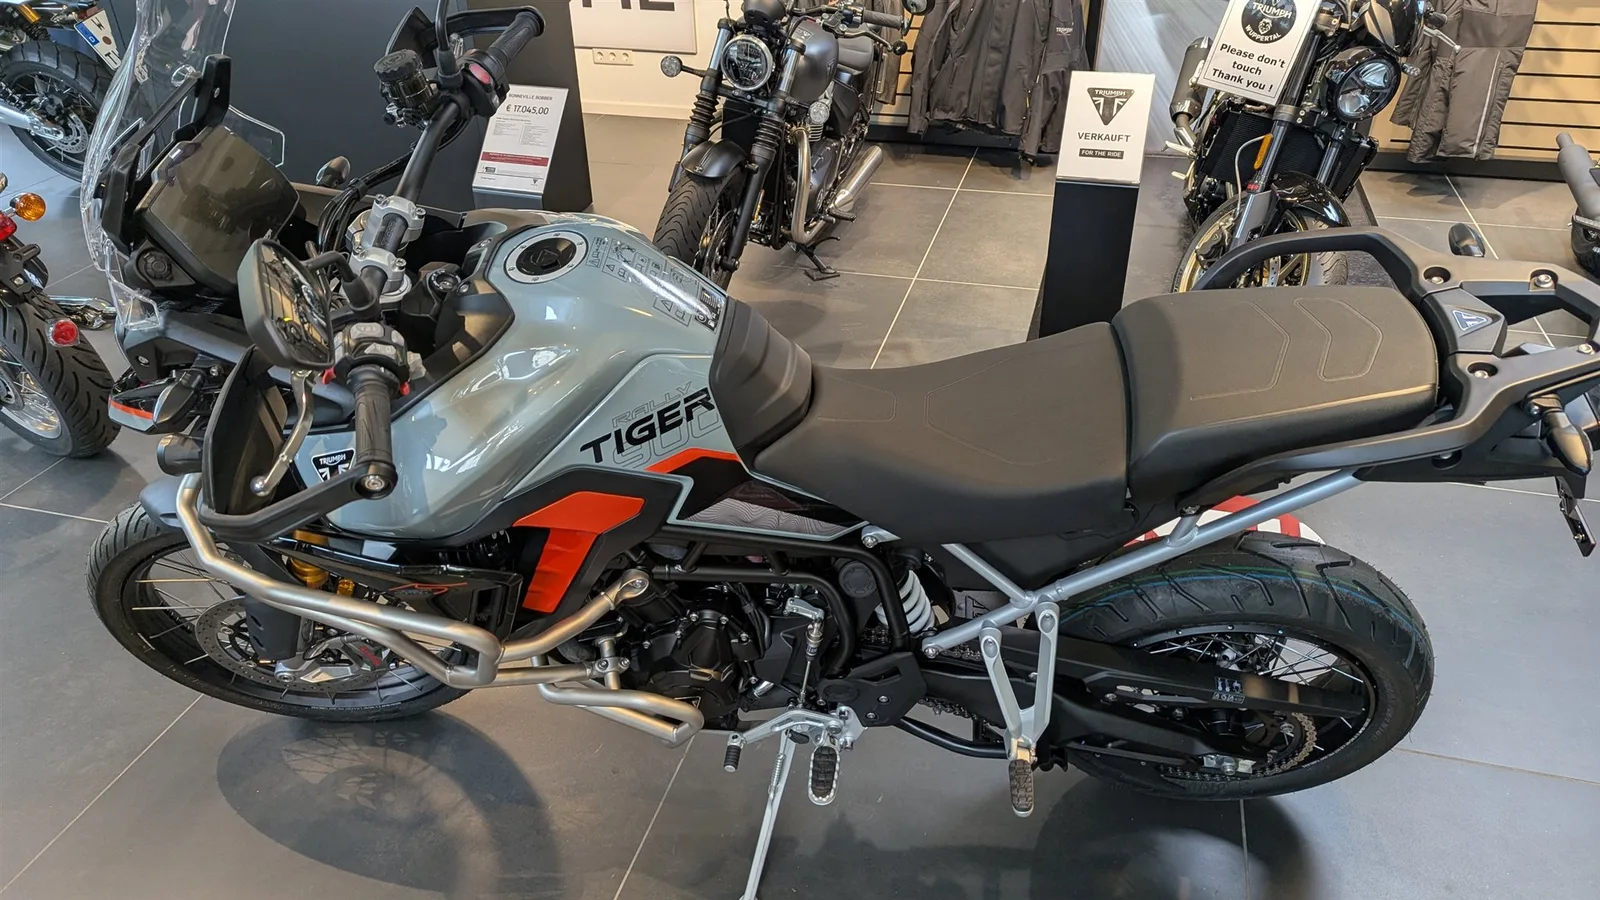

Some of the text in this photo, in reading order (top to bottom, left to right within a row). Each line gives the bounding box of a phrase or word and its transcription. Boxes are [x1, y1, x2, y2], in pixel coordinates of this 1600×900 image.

[1252, 2, 1292, 18] TRIUMPH
[1245, 24, 1281, 41] WUPPERTAL
[1220, 43, 1286, 69] Please don't
[1232, 60, 1262, 76] touch
[1212, 68, 1244, 84] Thank
[1246, 79, 1266, 91] you
[1095, 89, 1126, 97] TRIUMPH
[1077, 132, 1131, 142] VERKAUFT
[611, 381, 692, 428] RALLY
[580, 387, 715, 463] TIGER
[319, 453, 346, 465] TRIUMPH
